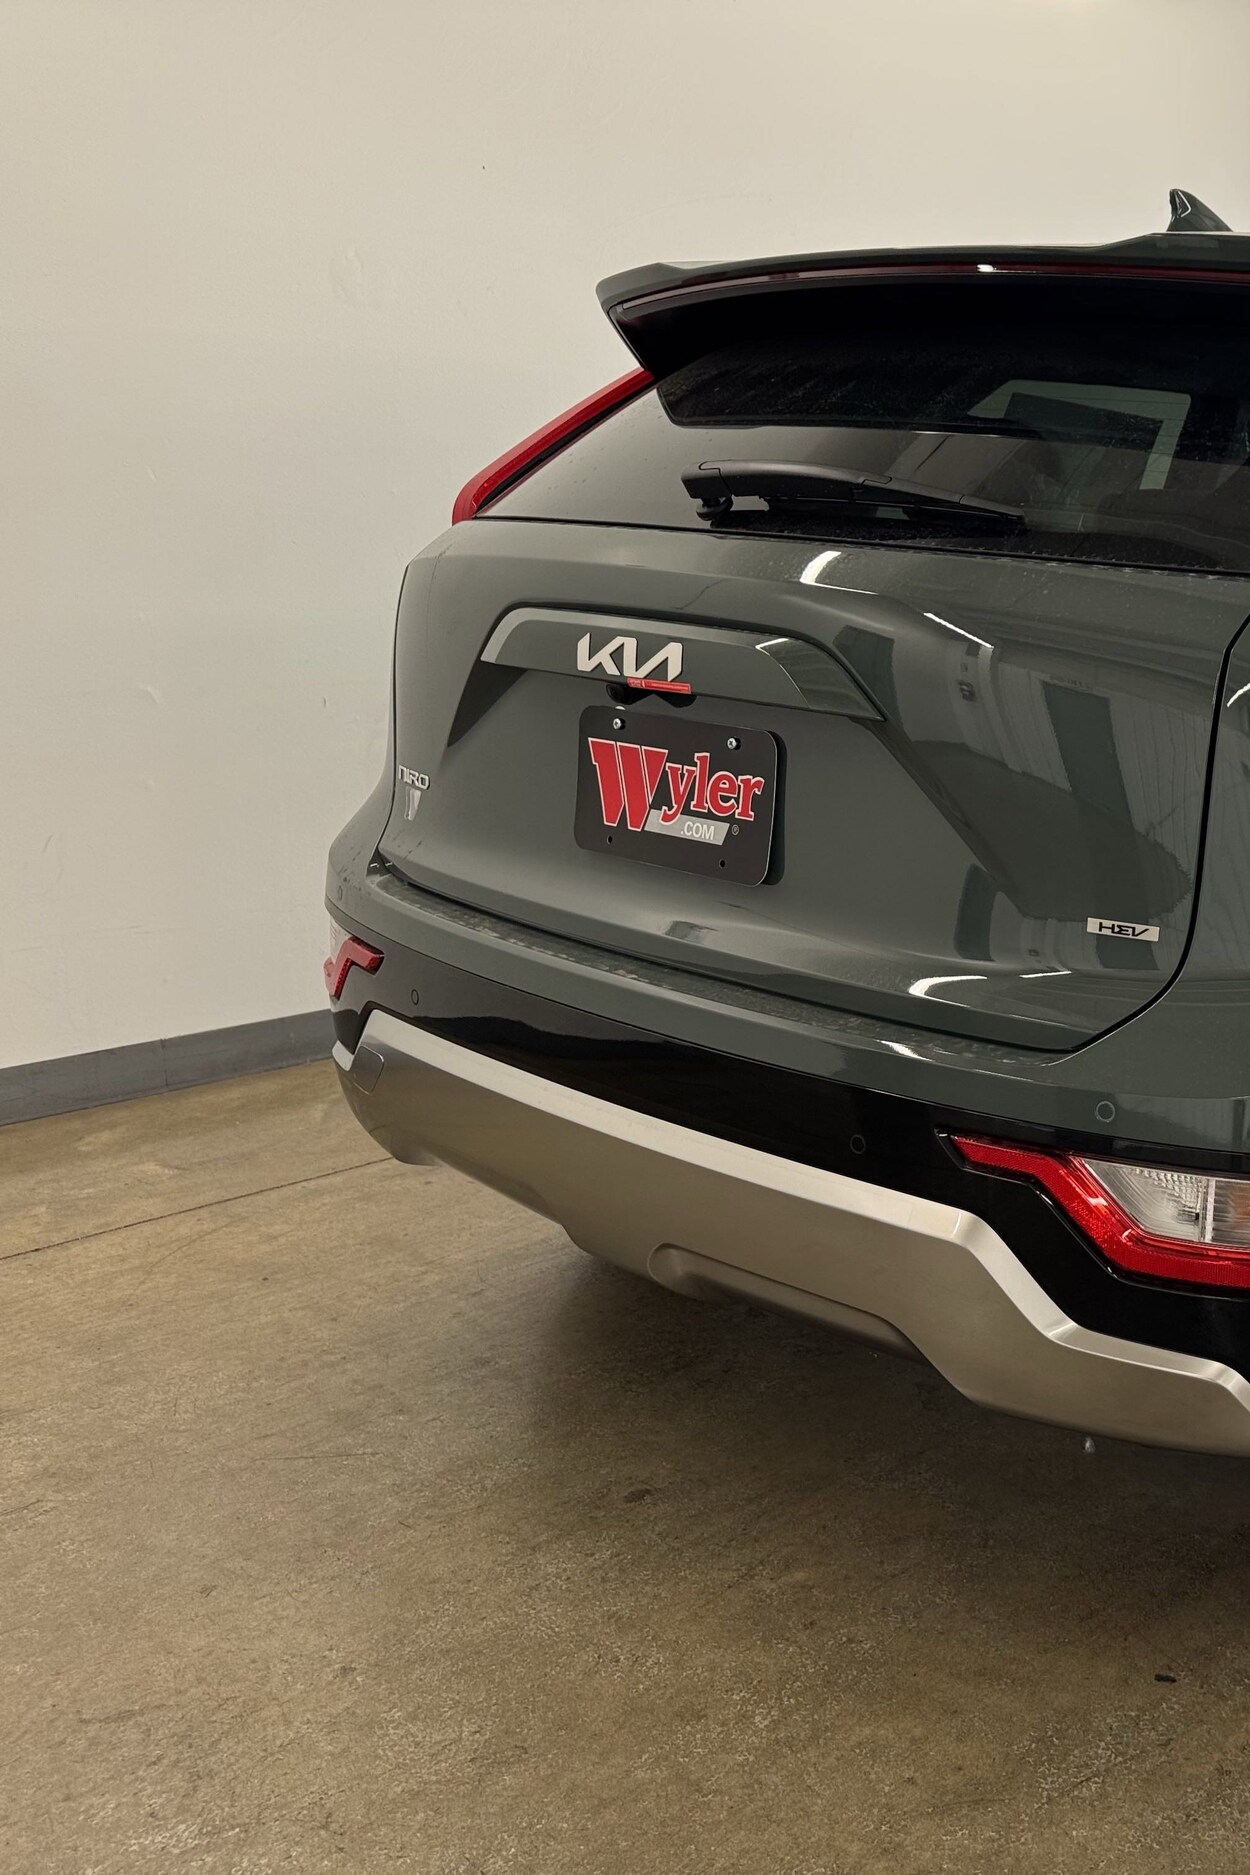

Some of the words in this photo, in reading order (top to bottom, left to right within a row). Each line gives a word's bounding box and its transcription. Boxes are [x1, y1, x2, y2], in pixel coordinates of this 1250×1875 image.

[577, 632, 684, 682] KIA
[588, 737, 765, 832] Wyler
[680, 820, 715, 841] .COM
[1098, 921, 1149, 937] HEV
